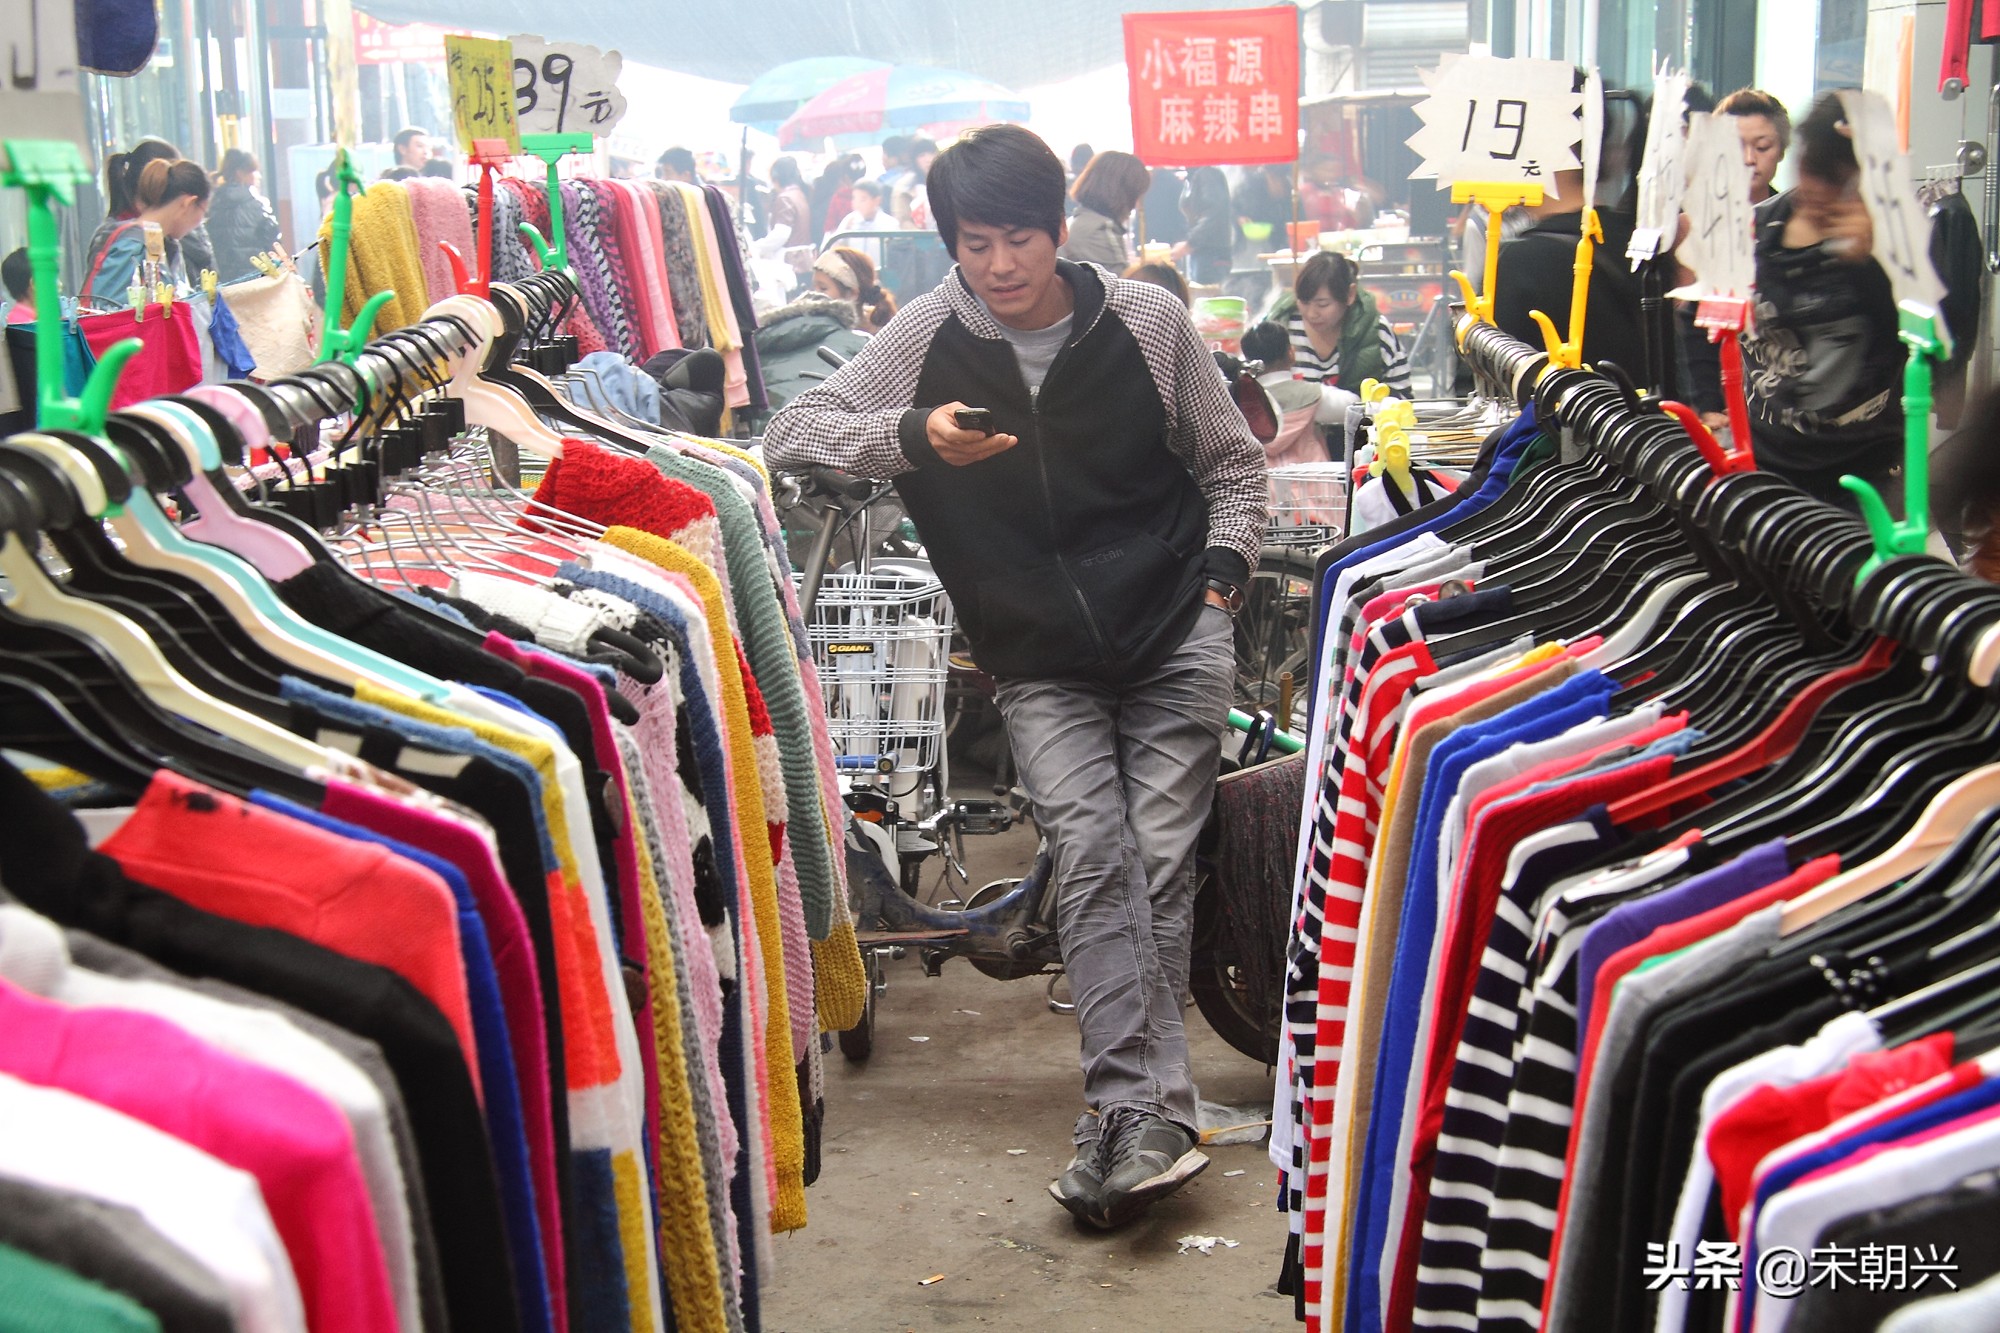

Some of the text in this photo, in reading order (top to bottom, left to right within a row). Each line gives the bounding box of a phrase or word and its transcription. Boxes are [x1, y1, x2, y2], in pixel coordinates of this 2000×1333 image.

[1140, 37, 1264, 90] 小福源
[1159, 89, 1283, 144] 麻辣串
